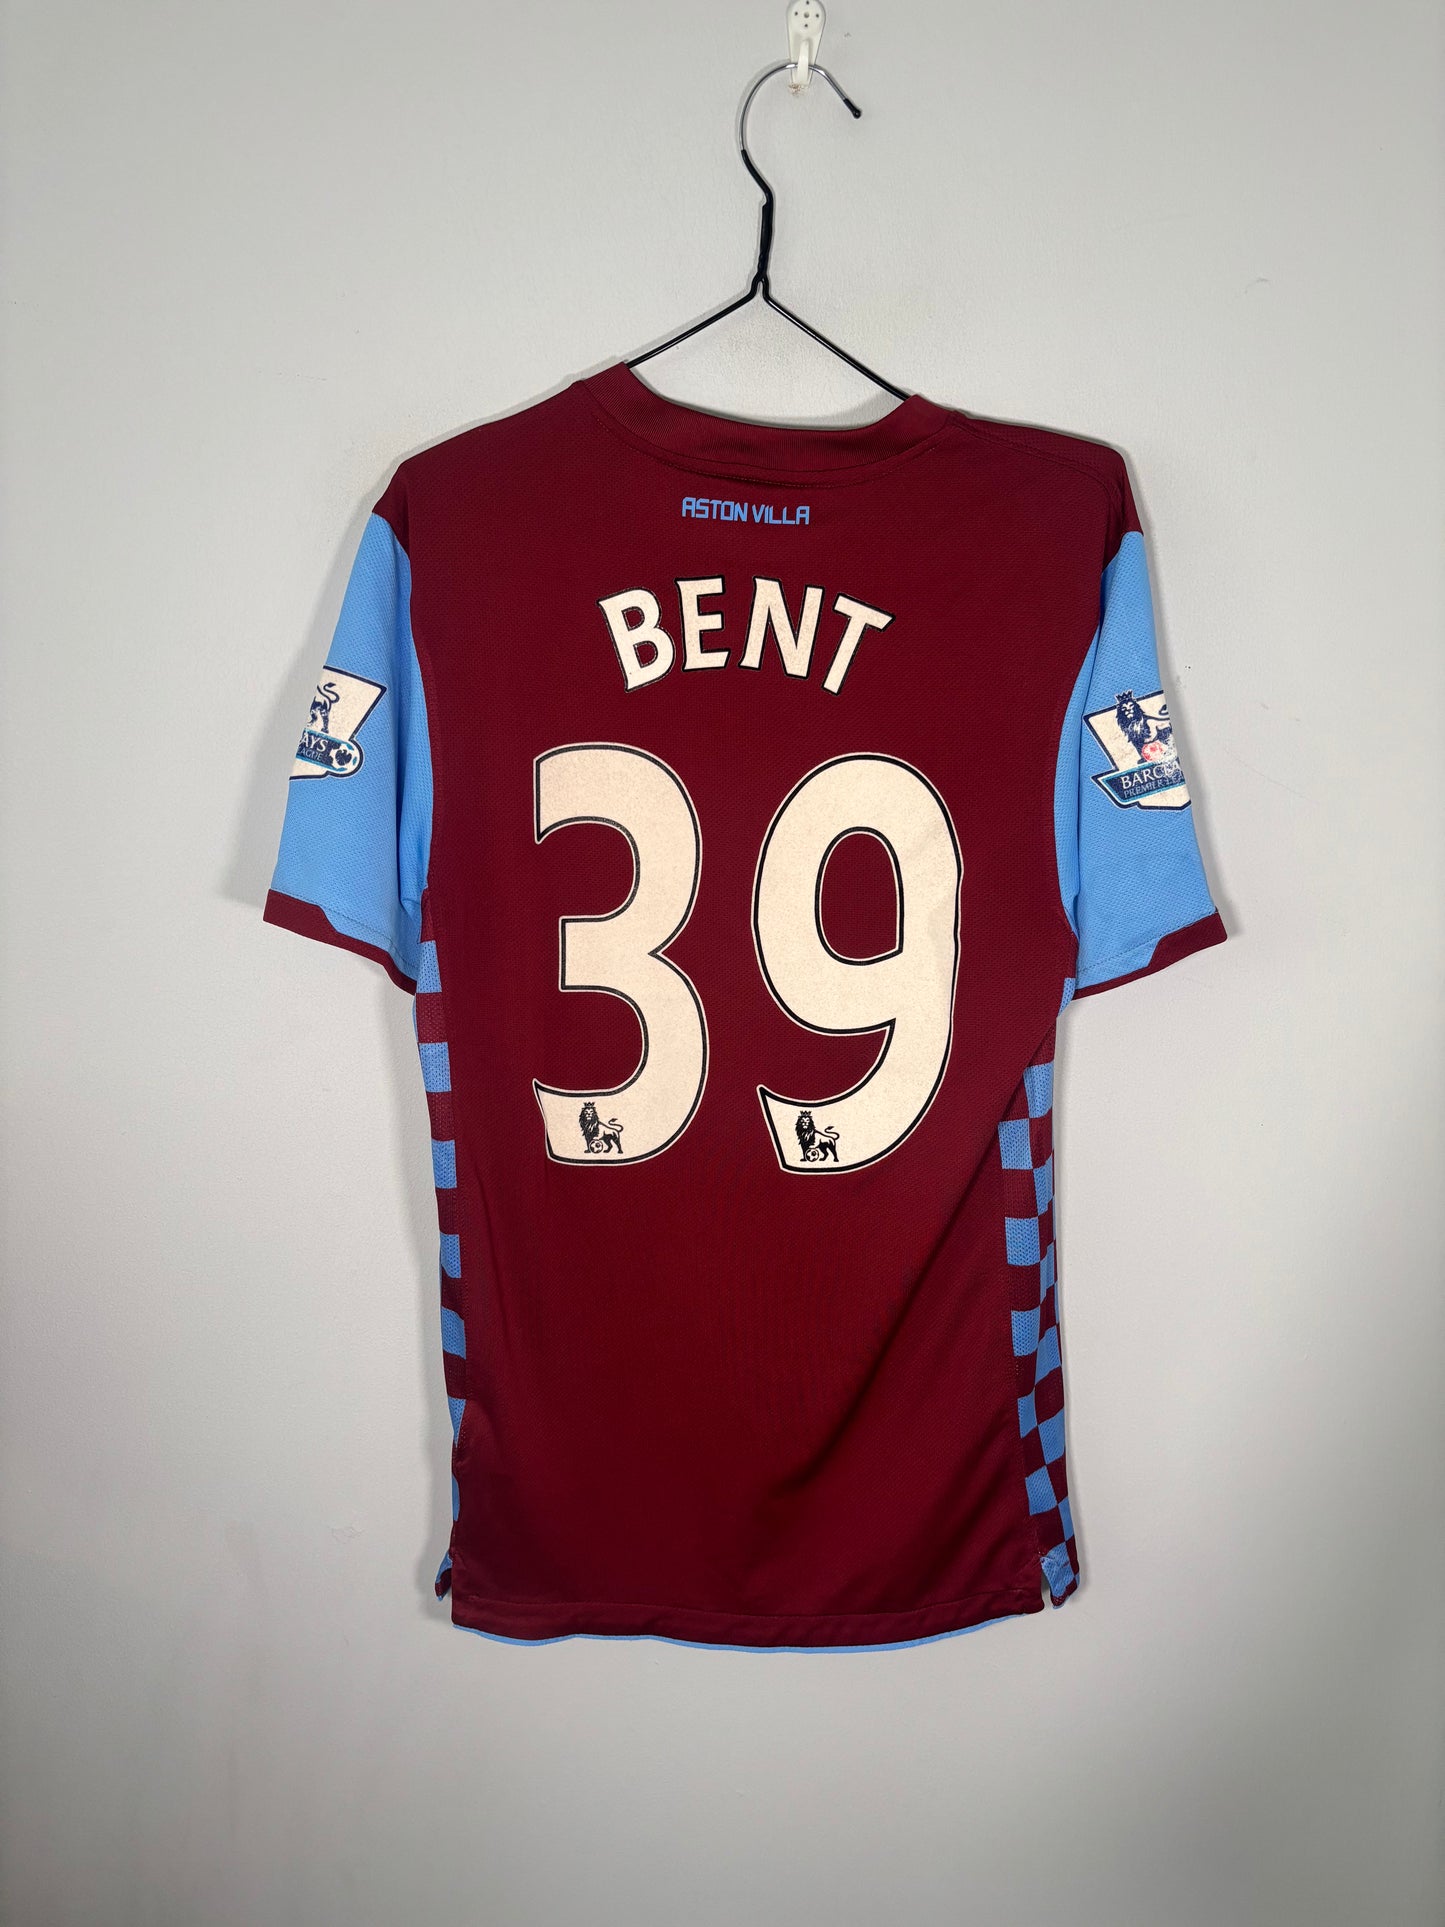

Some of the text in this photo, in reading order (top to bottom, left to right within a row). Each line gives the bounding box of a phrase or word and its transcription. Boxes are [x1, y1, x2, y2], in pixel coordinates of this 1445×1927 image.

[681, 496, 810, 525] ASTON VILLA
[597, 575, 896, 696] BENT
[533, 742, 964, 1175] 39
